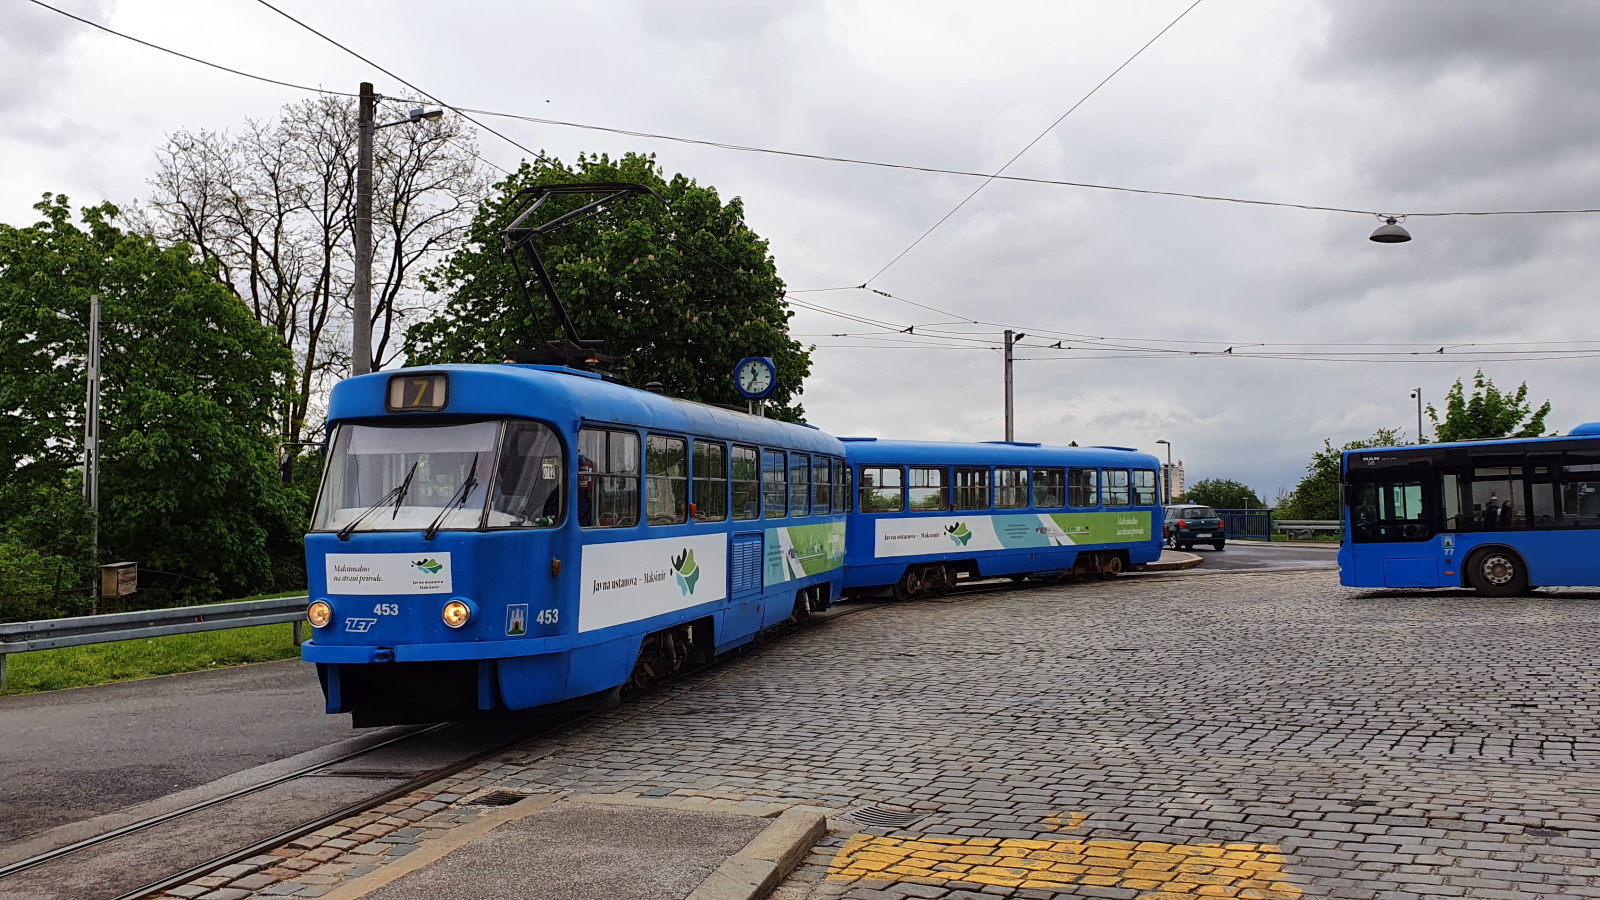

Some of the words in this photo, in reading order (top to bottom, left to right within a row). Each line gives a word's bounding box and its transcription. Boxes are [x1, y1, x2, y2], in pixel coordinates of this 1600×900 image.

[412, 380, 429, 407] 7
[592, 579, 611, 595] Javna
[611, 577, 638, 590] ustanova
[643, 569, 667, 584] Maksimir
[373, 603, 399, 616] 453
[536, 608, 559, 625] 453
[344, 617, 378, 633] ZET
